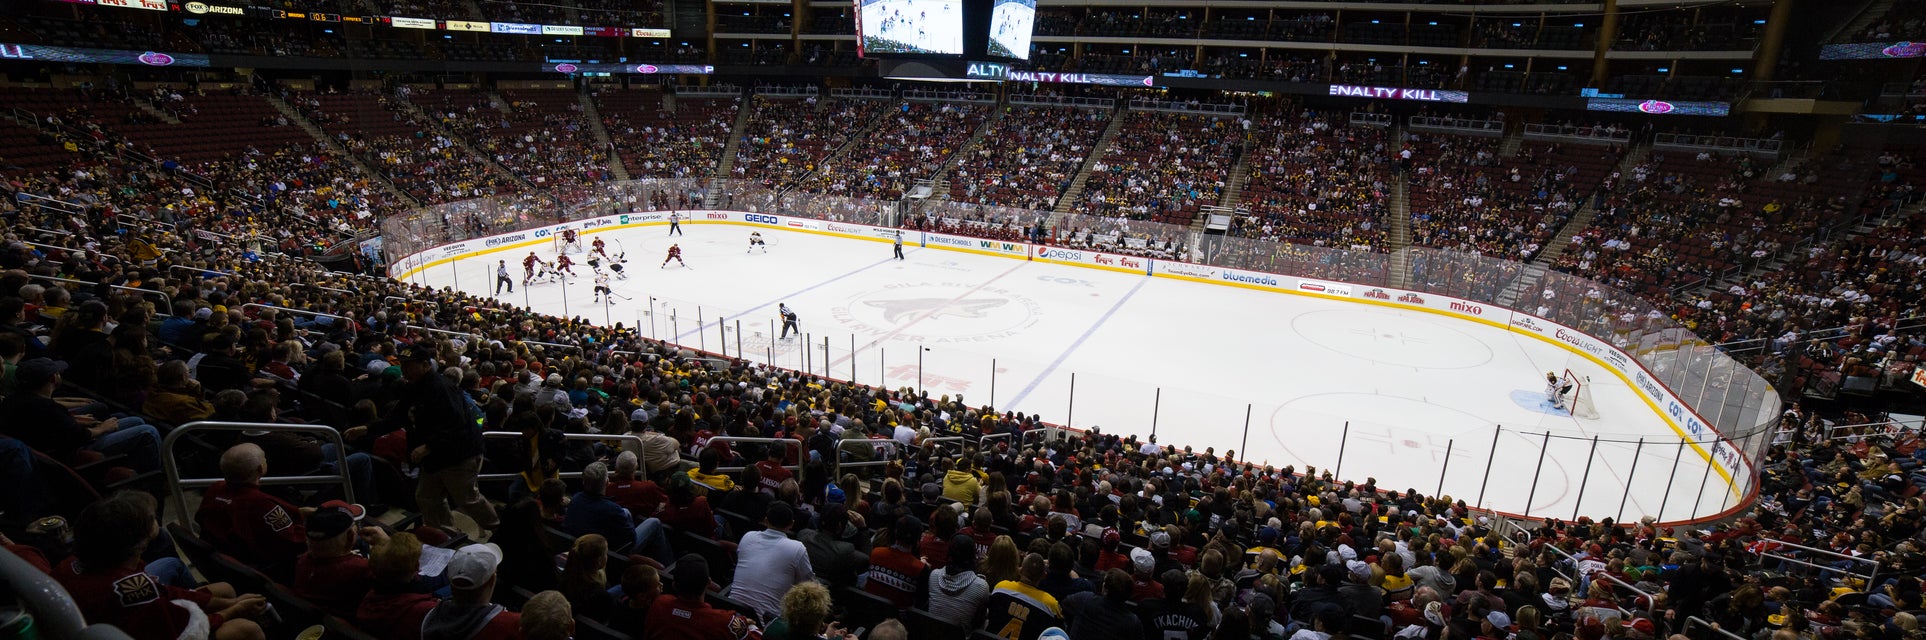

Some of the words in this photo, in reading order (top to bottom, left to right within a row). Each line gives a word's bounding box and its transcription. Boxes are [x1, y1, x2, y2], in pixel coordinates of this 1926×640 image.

[209, 6, 244, 15] ARIZONA
[967, 63, 1004, 77] ALTY
[1010, 71, 1055, 82] NALTY
[1060, 73, 1091, 83] KILL
[1402, 88, 1441, 101] KILL
[745, 214, 778, 225] GEICO
[502, 233, 526, 244] ARIZONA
[535, 229, 552, 238] COX
[935, 236, 952, 245] DESERT
[952, 238, 972, 247] SCHOOLS
[1049, 250, 1082, 261] pepsi
[1094, 254, 1114, 266] fry's
[1120, 257, 1140, 269] fry's
[1222, 270, 1277, 286] bluemedia
[1555, 327, 1581, 346] Coors
[1579, 340, 1604, 356] LIGHT
[1645, 381, 1664, 404] ARIZONA
[1669, 401, 1684, 423] COX
[1687, 417, 1703, 442] COX
[1590, 562, 1603, 570] DOAN
